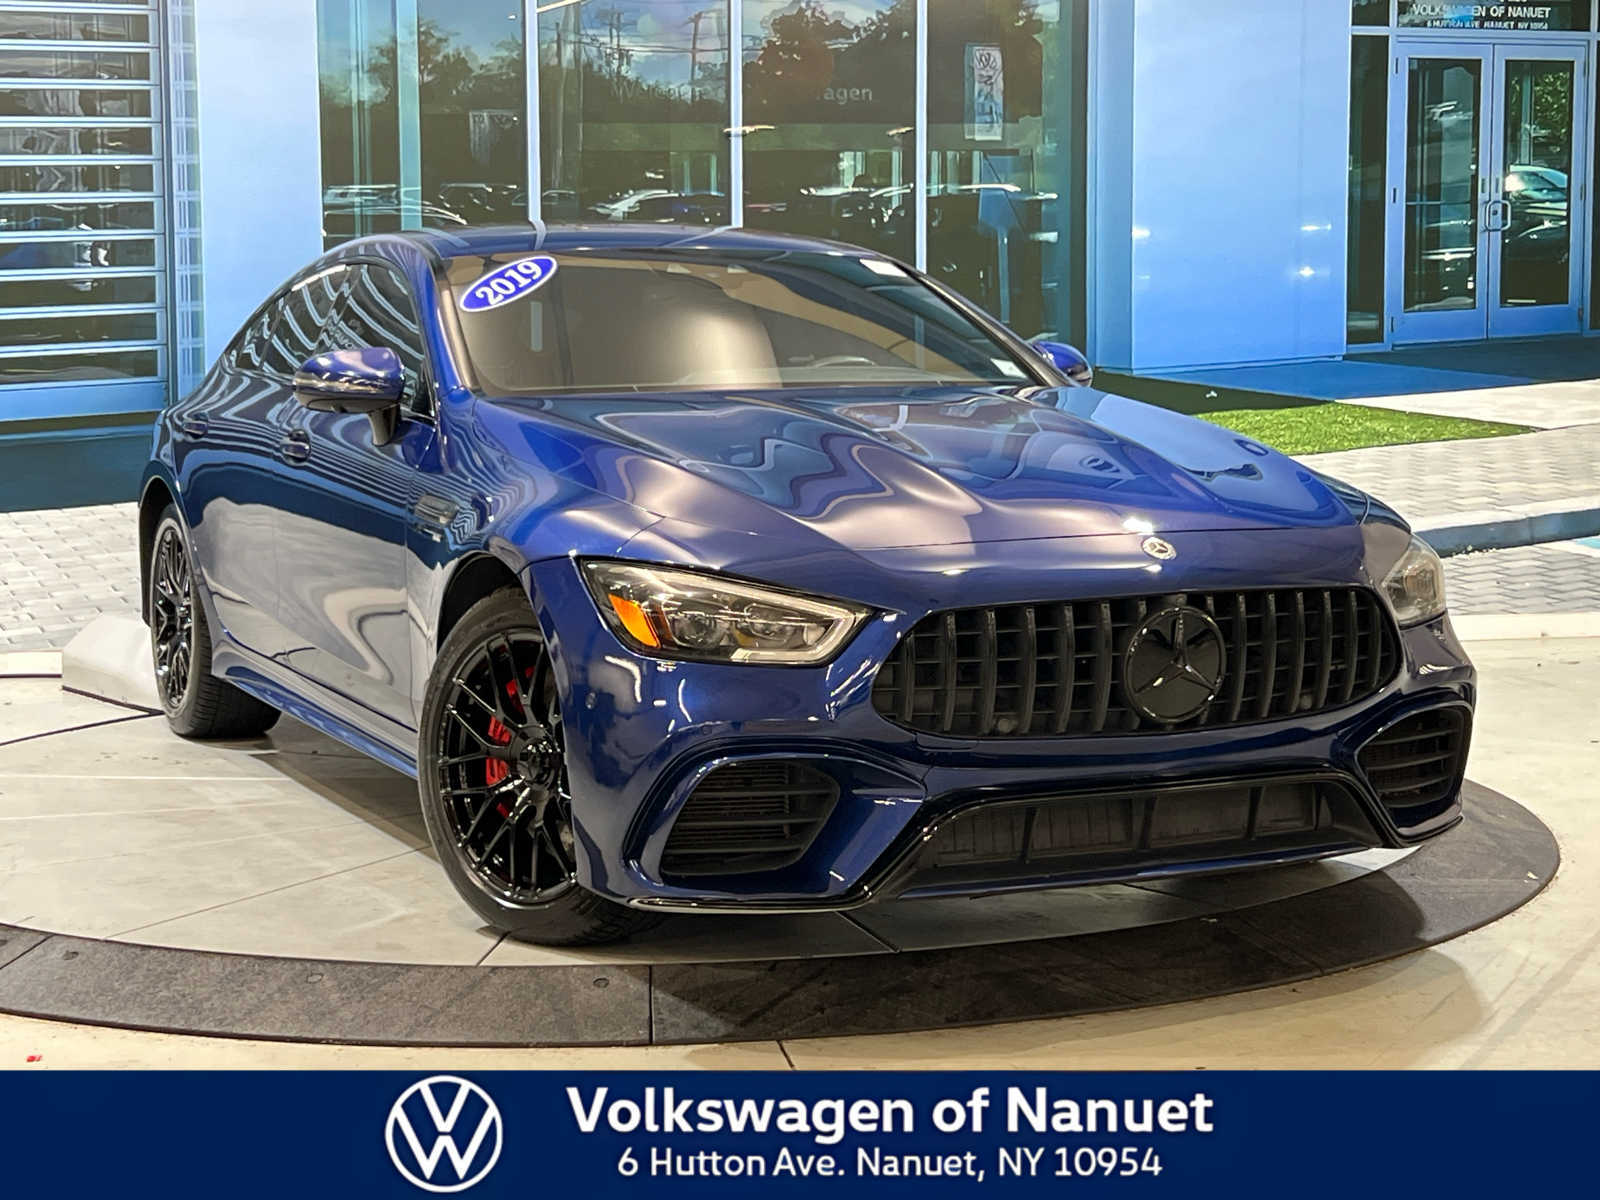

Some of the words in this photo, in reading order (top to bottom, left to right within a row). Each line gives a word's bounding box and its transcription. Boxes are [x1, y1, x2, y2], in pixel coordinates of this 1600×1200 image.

[1490, 5, 1505, 18] OF
[1507, 6, 1551, 18] NANUET
[475, 261, 543, 305] 2019
